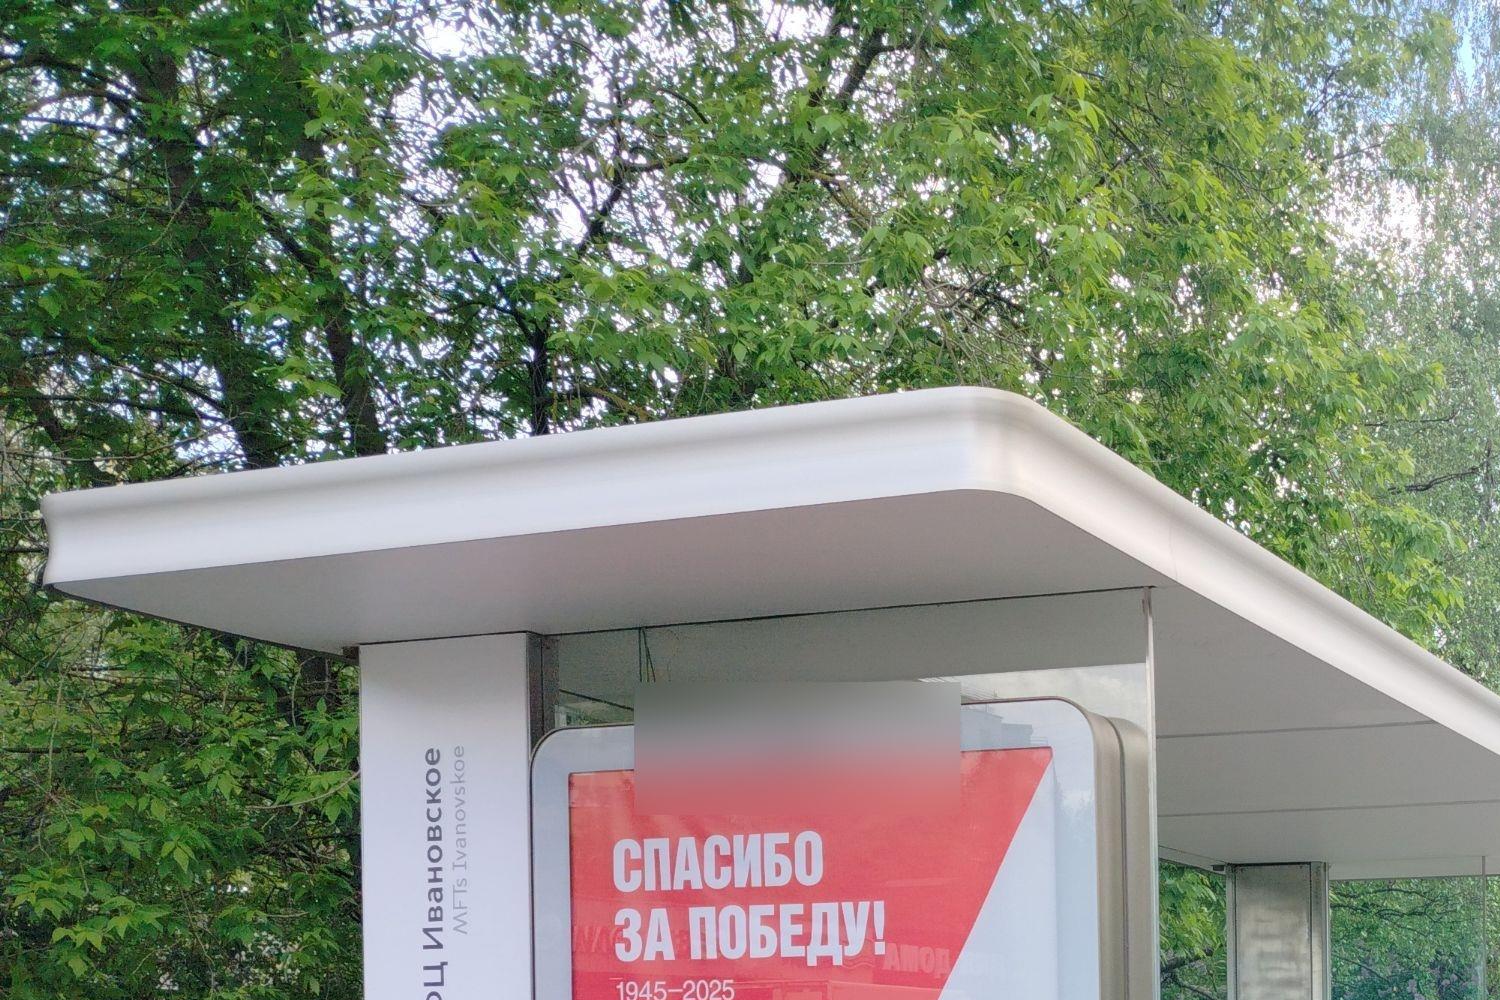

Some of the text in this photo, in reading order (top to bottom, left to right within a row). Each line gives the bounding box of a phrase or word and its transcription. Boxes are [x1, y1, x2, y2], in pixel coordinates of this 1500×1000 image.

[422, 748, 444, 950] Ивановское
[450, 745, 468, 935] MFTs Ivanovskoe
[613, 830, 823, 893] СПАСИБО
[614, 908, 676, 962] ЗА
[688, 900, 886, 967] ПОБЕДУ!
